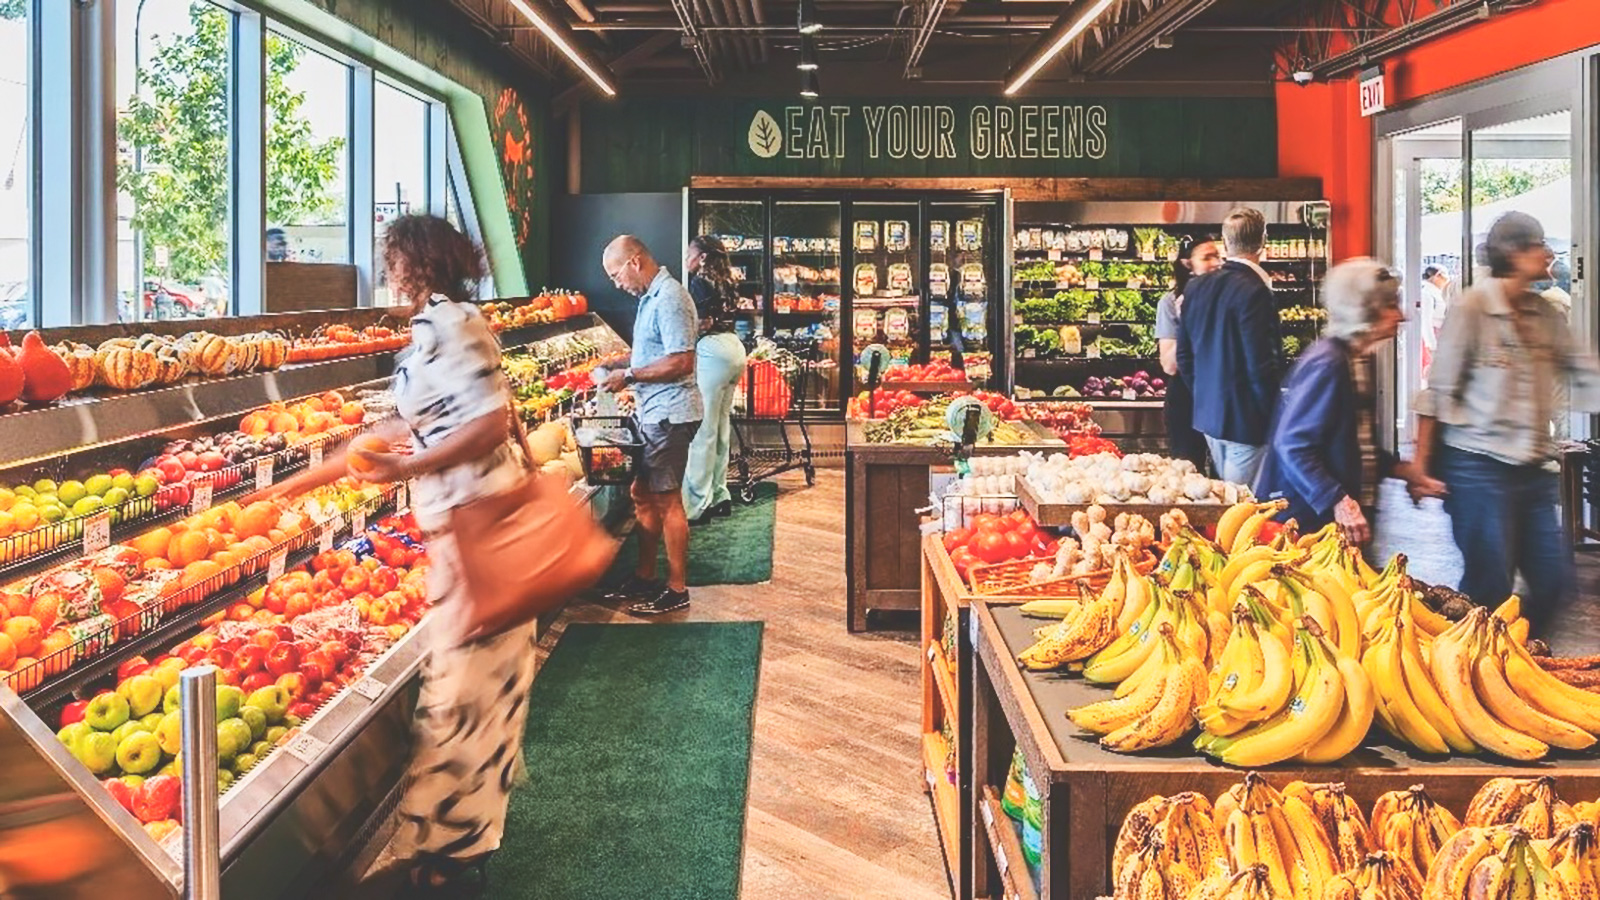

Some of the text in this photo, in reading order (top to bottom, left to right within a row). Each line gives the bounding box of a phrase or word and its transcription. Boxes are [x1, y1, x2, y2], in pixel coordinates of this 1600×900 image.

[1363, 82, 1380, 109] EXIT
[785, 105, 1107, 159] EAT YOUR GREENS
